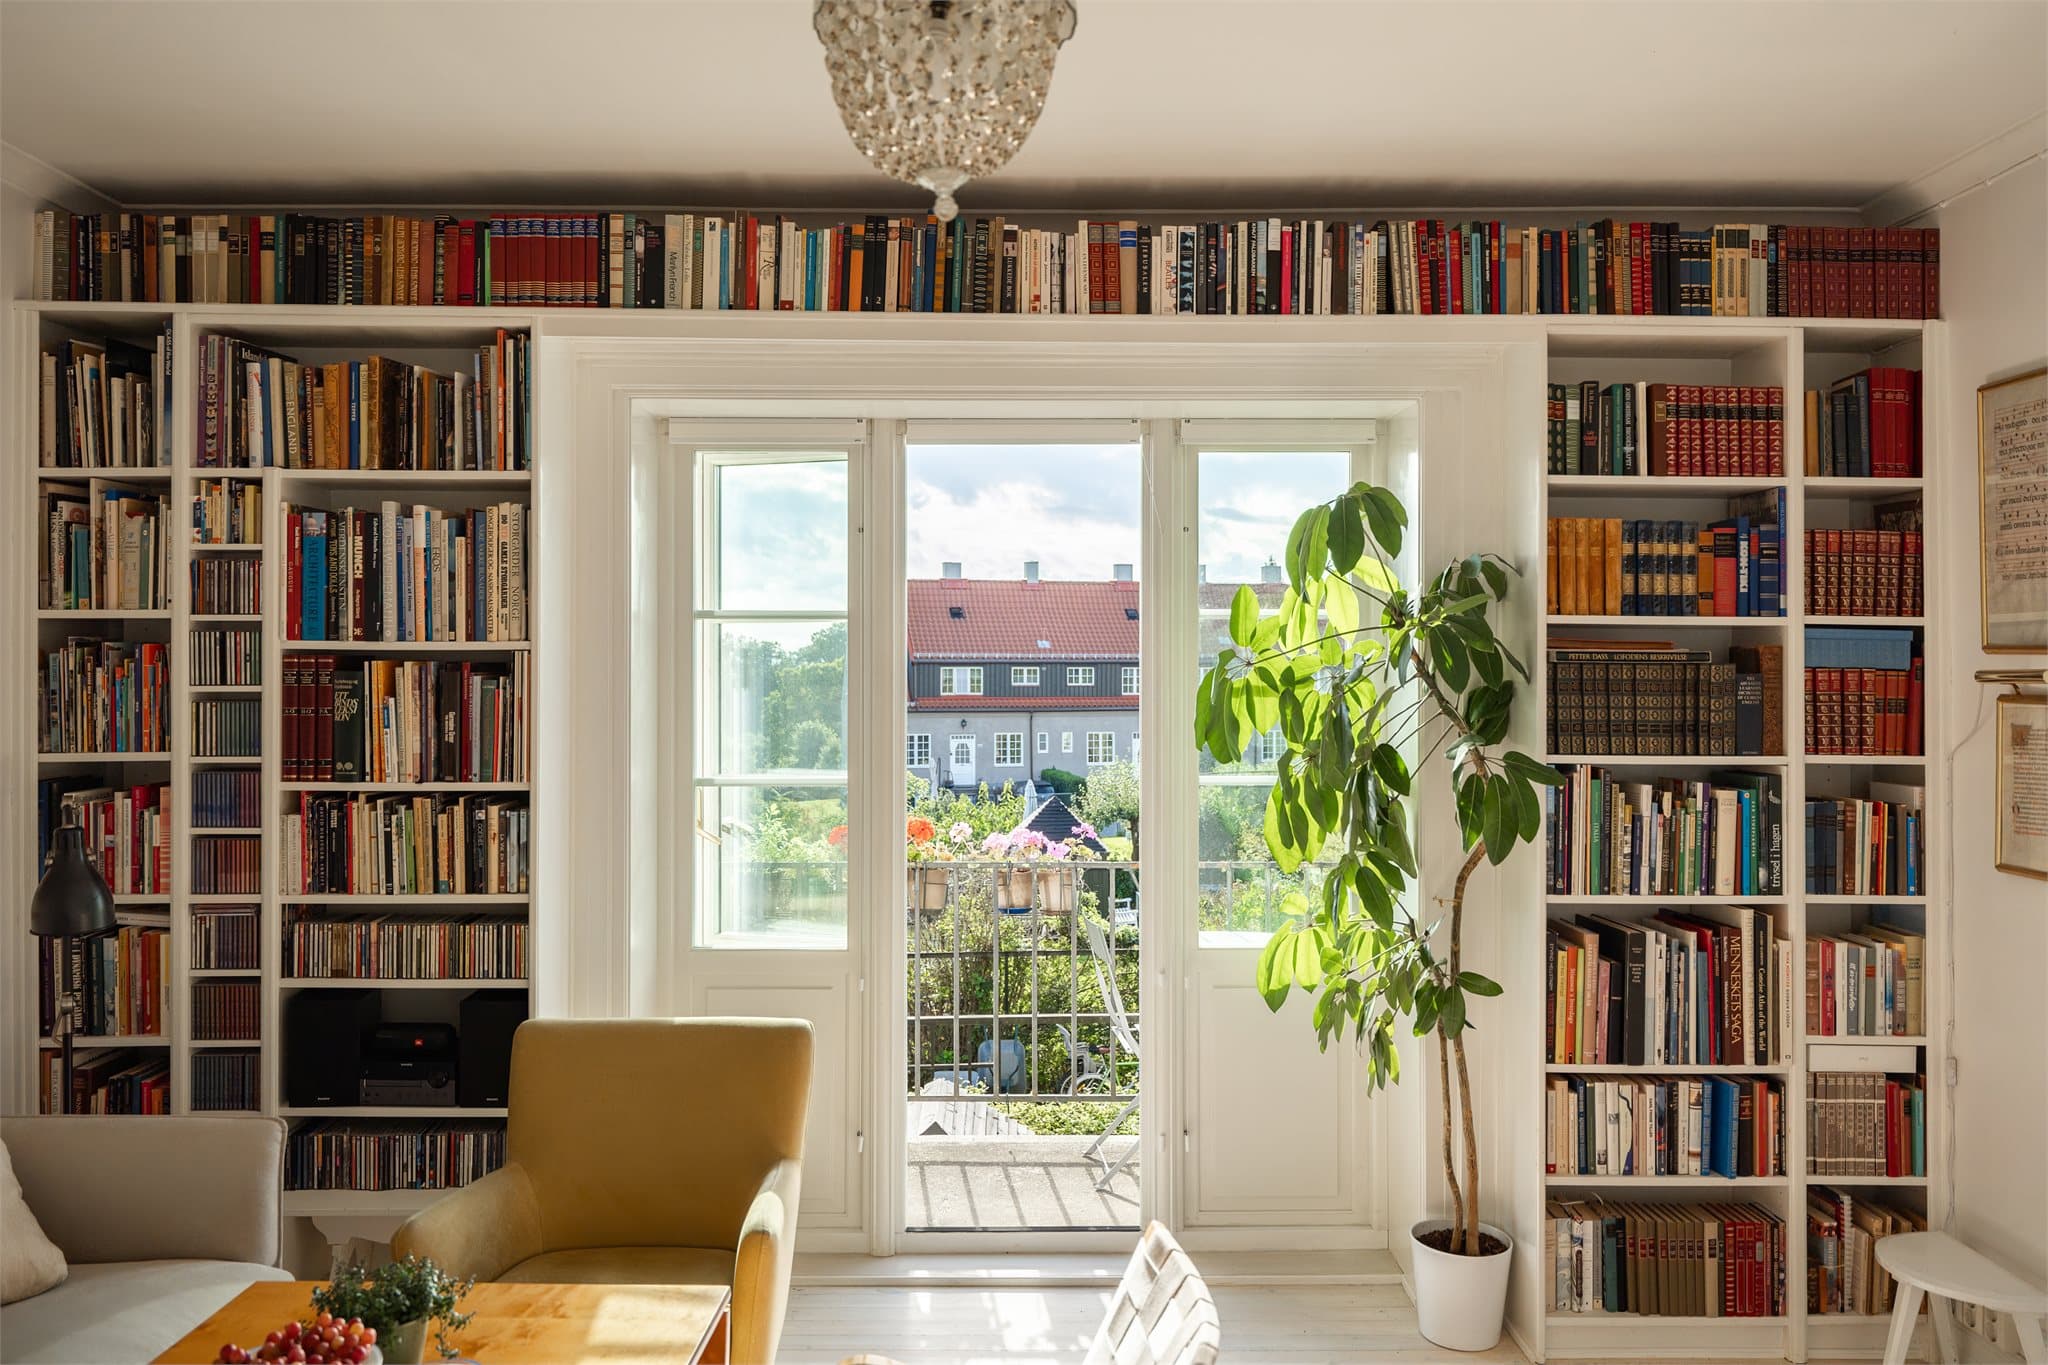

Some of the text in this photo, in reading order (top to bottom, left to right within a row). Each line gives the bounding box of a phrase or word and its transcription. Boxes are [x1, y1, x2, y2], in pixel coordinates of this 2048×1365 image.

[668, 251, 678, 302] Marilyn French
[286, 401, 298, 454] ENGLAND
[329, 540, 338, 556] TOYS
[354, 535, 363, 579] MUNCH
[432, 547, 441, 573] EROS
[329, 556, 338, 571] AND
[338, 521, 347, 609] VERDENSKUNSTEN
[1739, 541, 1749, 593] KON-TIKI
[307, 540, 320, 622] ARCHITECTURE
[329, 572, 338, 593] DOLLS
[511, 586, 521, 622] NORGE
[1568, 653, 1590, 661] PETTER
[1592, 653, 1608, 661] DASS
[1770, 823, 1781, 852] hagen
[1770, 860, 1781, 888] trivsel
[1730, 935, 1742, 1045] MENNESKETS SAGA
[1758, 967, 1766, 993] Concise
[1758, 994, 1766, 1010] Atlas
[1758, 1018, 1766, 1029] the
[1758, 1030, 1767, 1051] World
